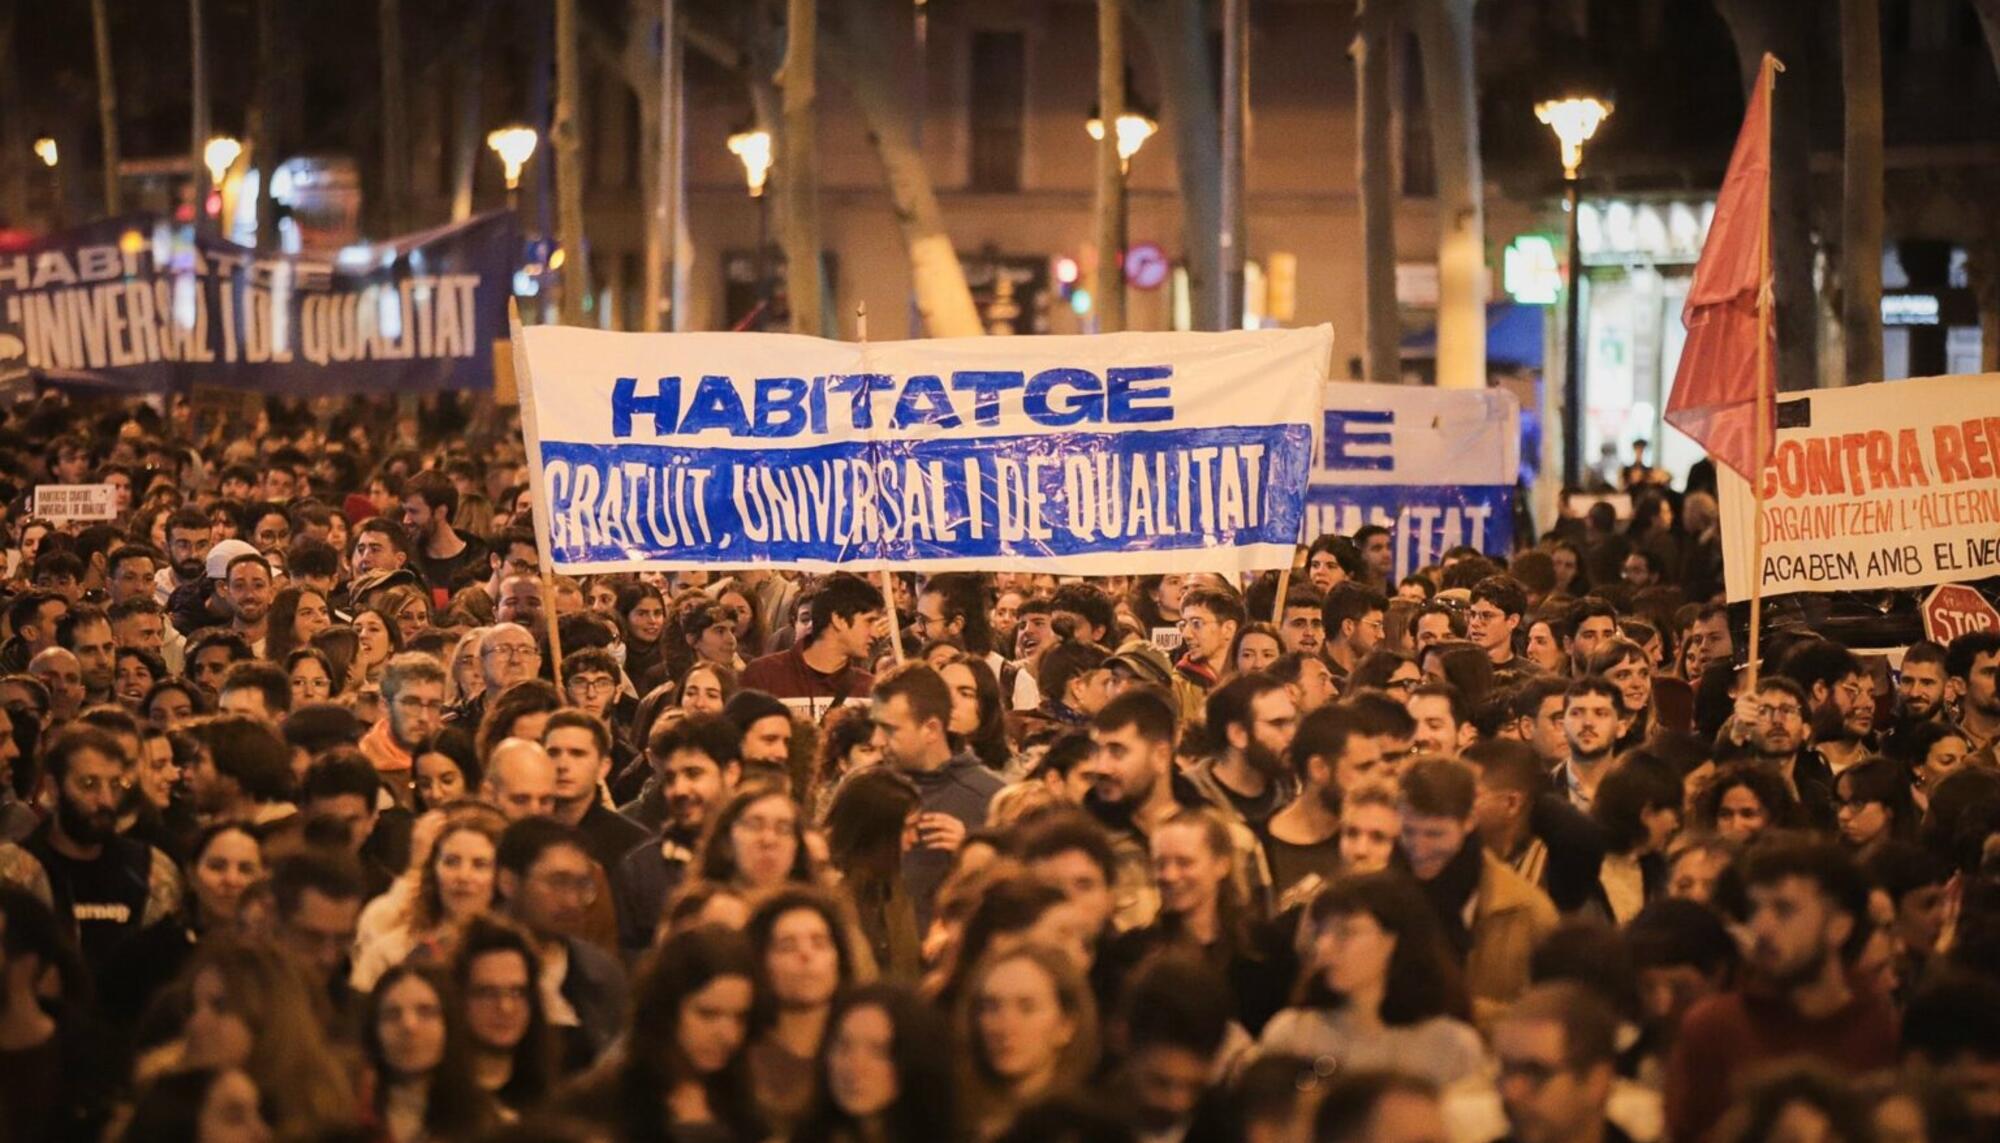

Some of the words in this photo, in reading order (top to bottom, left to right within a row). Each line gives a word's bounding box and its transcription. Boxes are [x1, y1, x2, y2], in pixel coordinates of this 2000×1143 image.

[302, 275, 481, 366] QUALITAT
[611, 364, 1174, 438] HABITATGE
[543, 455, 732, 550] GRATUÏT,
[733, 457, 957, 546] UNIVERSAL
[964, 457, 983, 540] I
[996, 455, 1053, 542] DE
[1065, 444, 1265, 542] QUALITAT
[1762, 551, 1860, 586] ACABEM
[1866, 545, 1923, 578] AMB
[1933, 542, 1962, 571] EL
[1966, 538, 2000, 569] NE
[1934, 607, 1992, 648] STOP
